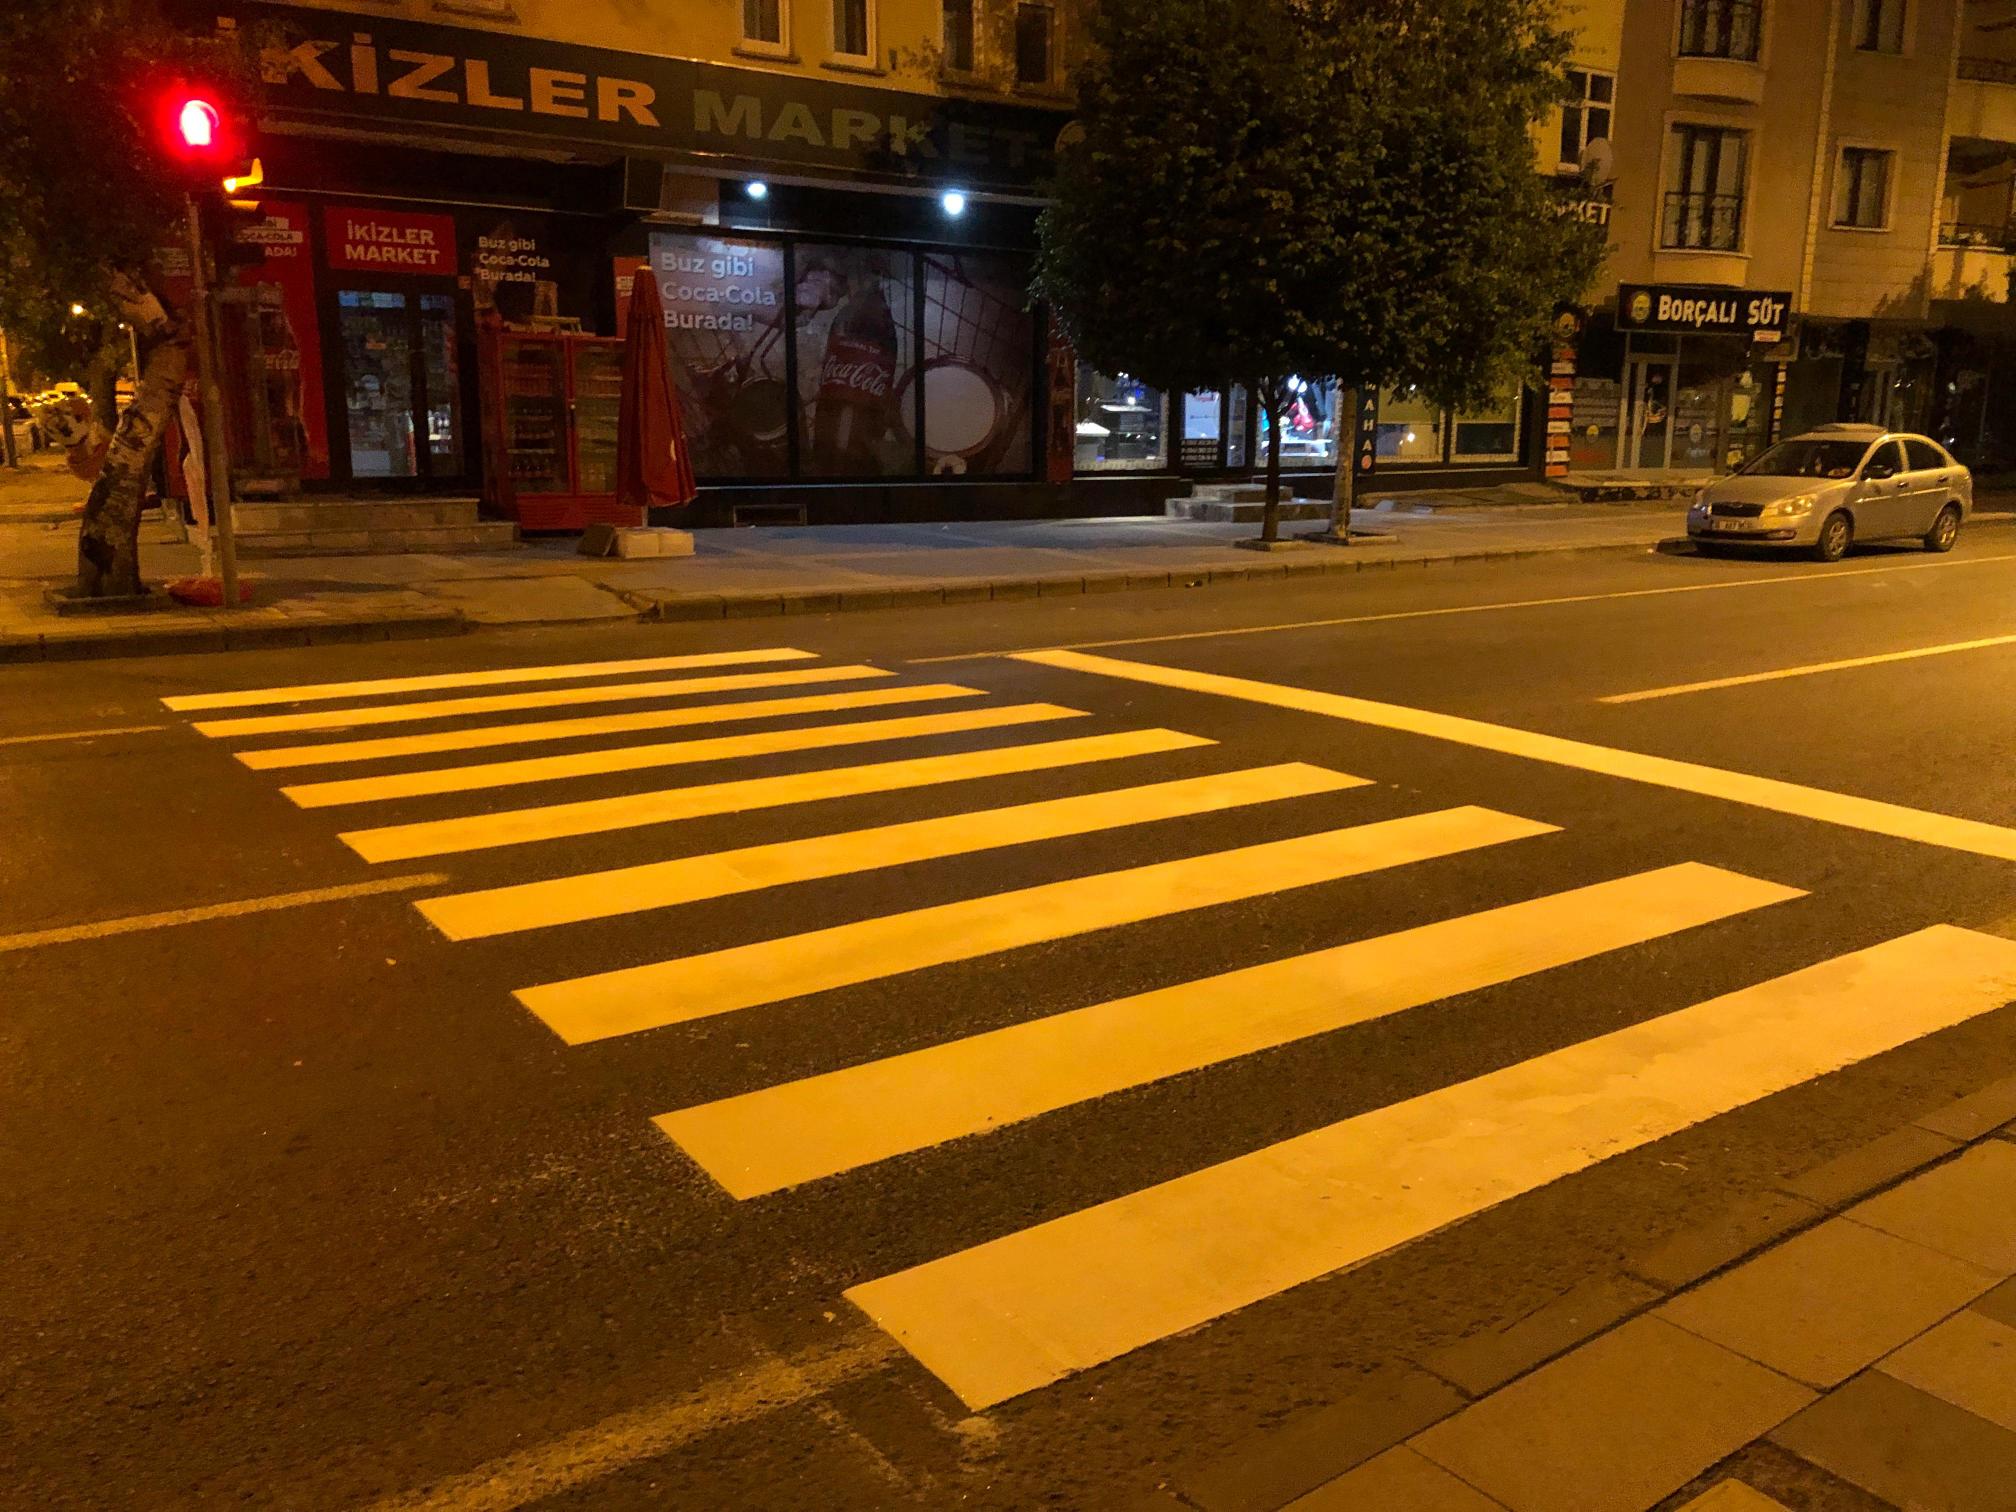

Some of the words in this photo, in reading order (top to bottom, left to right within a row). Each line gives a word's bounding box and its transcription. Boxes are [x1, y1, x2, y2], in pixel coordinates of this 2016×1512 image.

[217, 17, 660, 127] KİZLER
[693, 90, 1042, 168] MARKET
[347, 219, 435, 246] İKİZLER
[478, 236, 506, 249] Buz
[508, 239, 536, 252] gibi
[345, 243, 440, 265] MARKET
[479, 252, 551, 268] Coca-Cola
[661, 252, 704, 273] Buz
[711, 255, 753, 278] gibi
[480, 268, 536, 283] Burada!
[662, 281, 776, 305] Coca-Cola
[664, 310, 752, 332] Burada!
[1657, 294, 1737, 328] BORÇALI
[1747, 296, 1784, 325] SÜT
